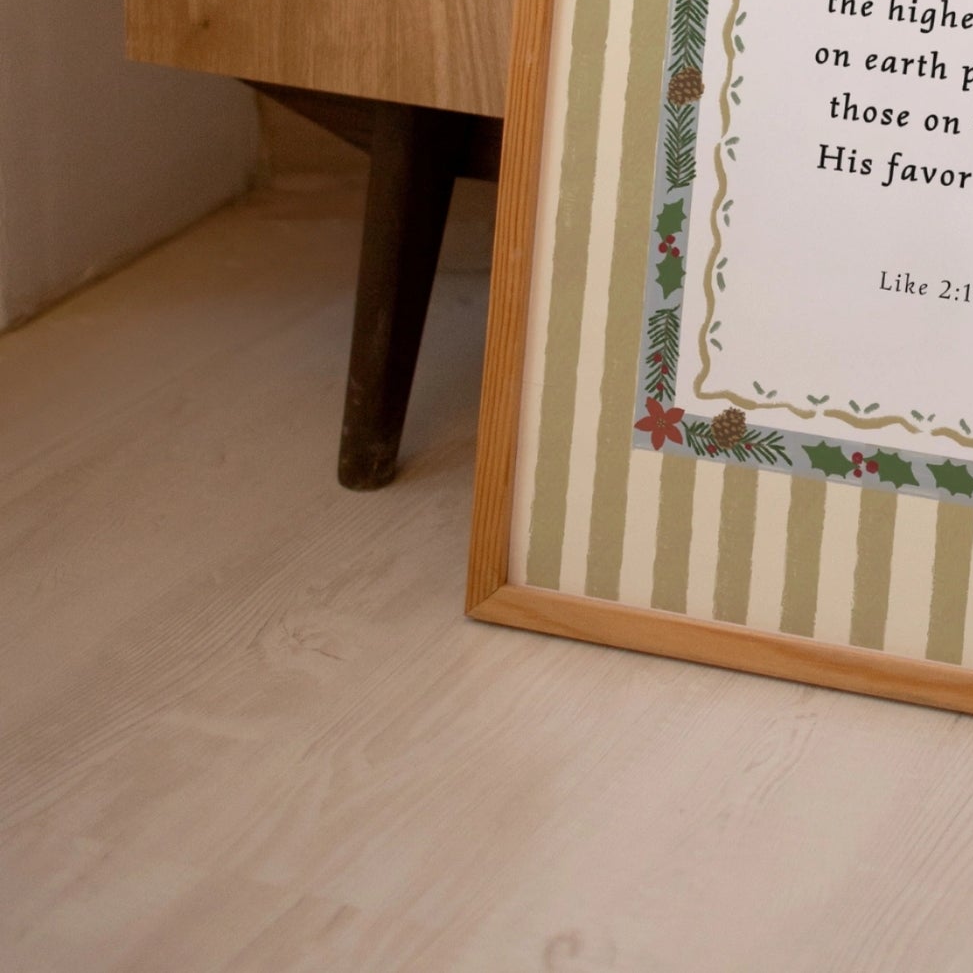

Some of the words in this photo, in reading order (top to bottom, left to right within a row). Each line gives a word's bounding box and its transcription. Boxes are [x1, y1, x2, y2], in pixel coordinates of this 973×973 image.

[815, 47, 850, 68] on
[865, 50, 947, 80] earth
[829, 92, 910, 128] those
[924, 114, 960, 135] on
[817, 143, 873, 175] His
[881, 151, 972, 189] favor
[880, 271, 928, 296] Like
